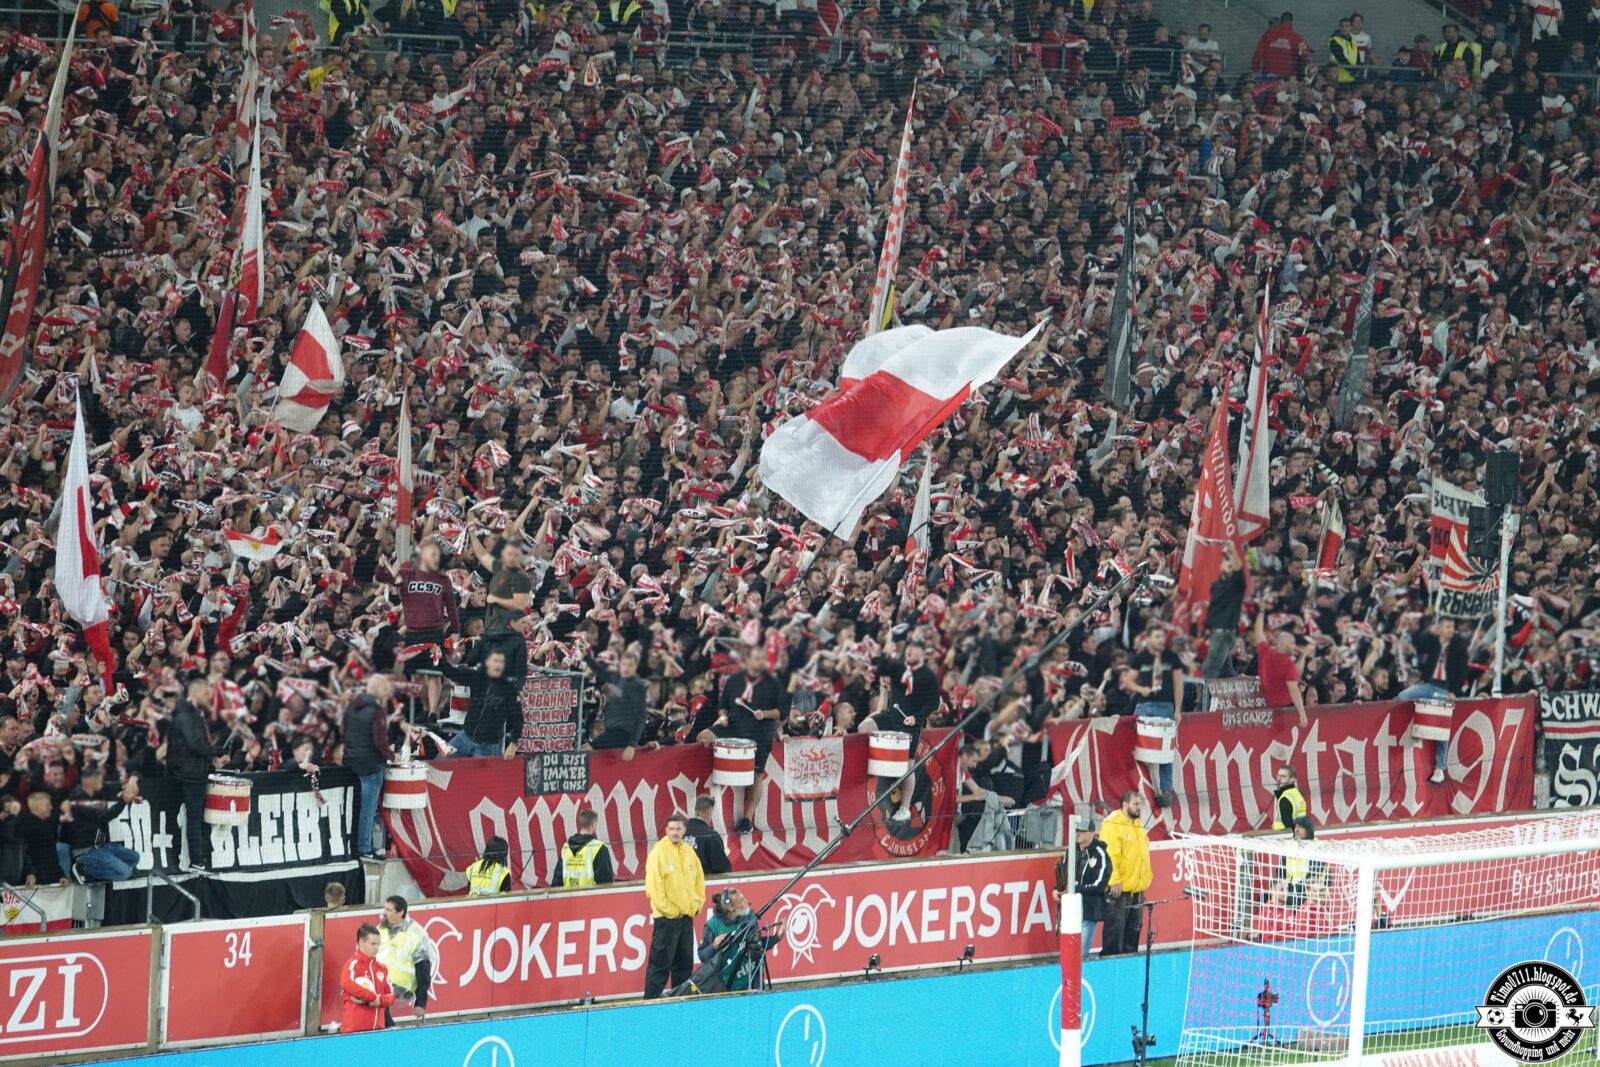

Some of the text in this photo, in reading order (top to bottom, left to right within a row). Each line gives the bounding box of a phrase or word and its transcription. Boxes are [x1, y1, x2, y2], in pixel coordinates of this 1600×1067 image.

[408, 581, 442, 595] CC97
[523, 678, 572, 691] JEDER
[1541, 692, 1600, 720] SCHW
[543, 753, 587, 766] DU BIST
[1447, 708, 1525, 815] 97
[543, 766, 587, 780] IMMER
[543, 780, 586, 792] BEI UNS!
[1172, 850, 1194, 882] 35
[832, 879, 1054, 951] JOKERSTA
[224, 931, 252, 969] 34
